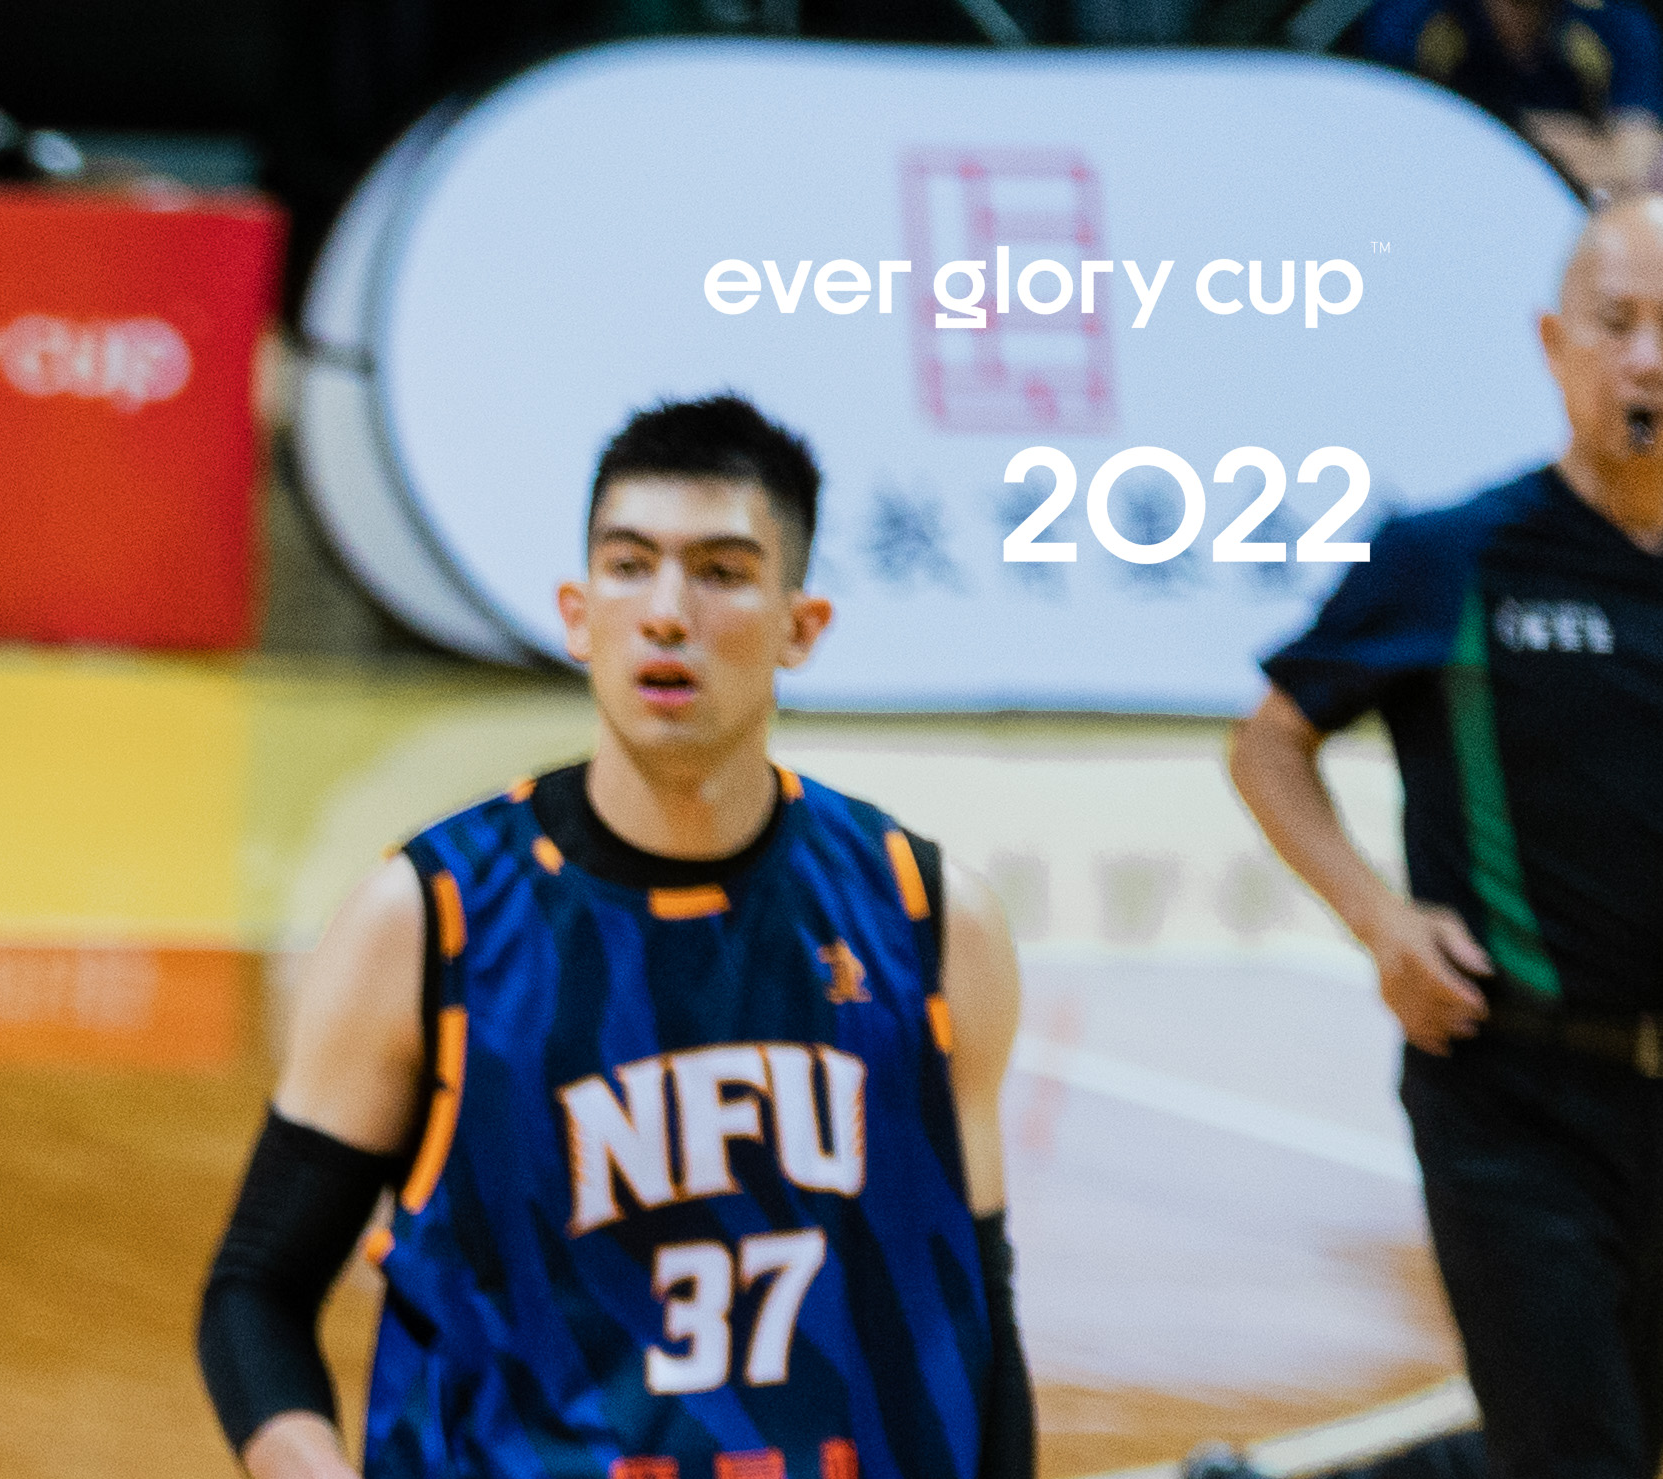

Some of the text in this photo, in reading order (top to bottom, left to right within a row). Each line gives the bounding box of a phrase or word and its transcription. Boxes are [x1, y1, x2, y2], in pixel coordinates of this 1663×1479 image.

[0, 306, 192, 410] cup
[553, 1042, 868, 1238] NFU
[644, 1226, 827, 1396] 37
